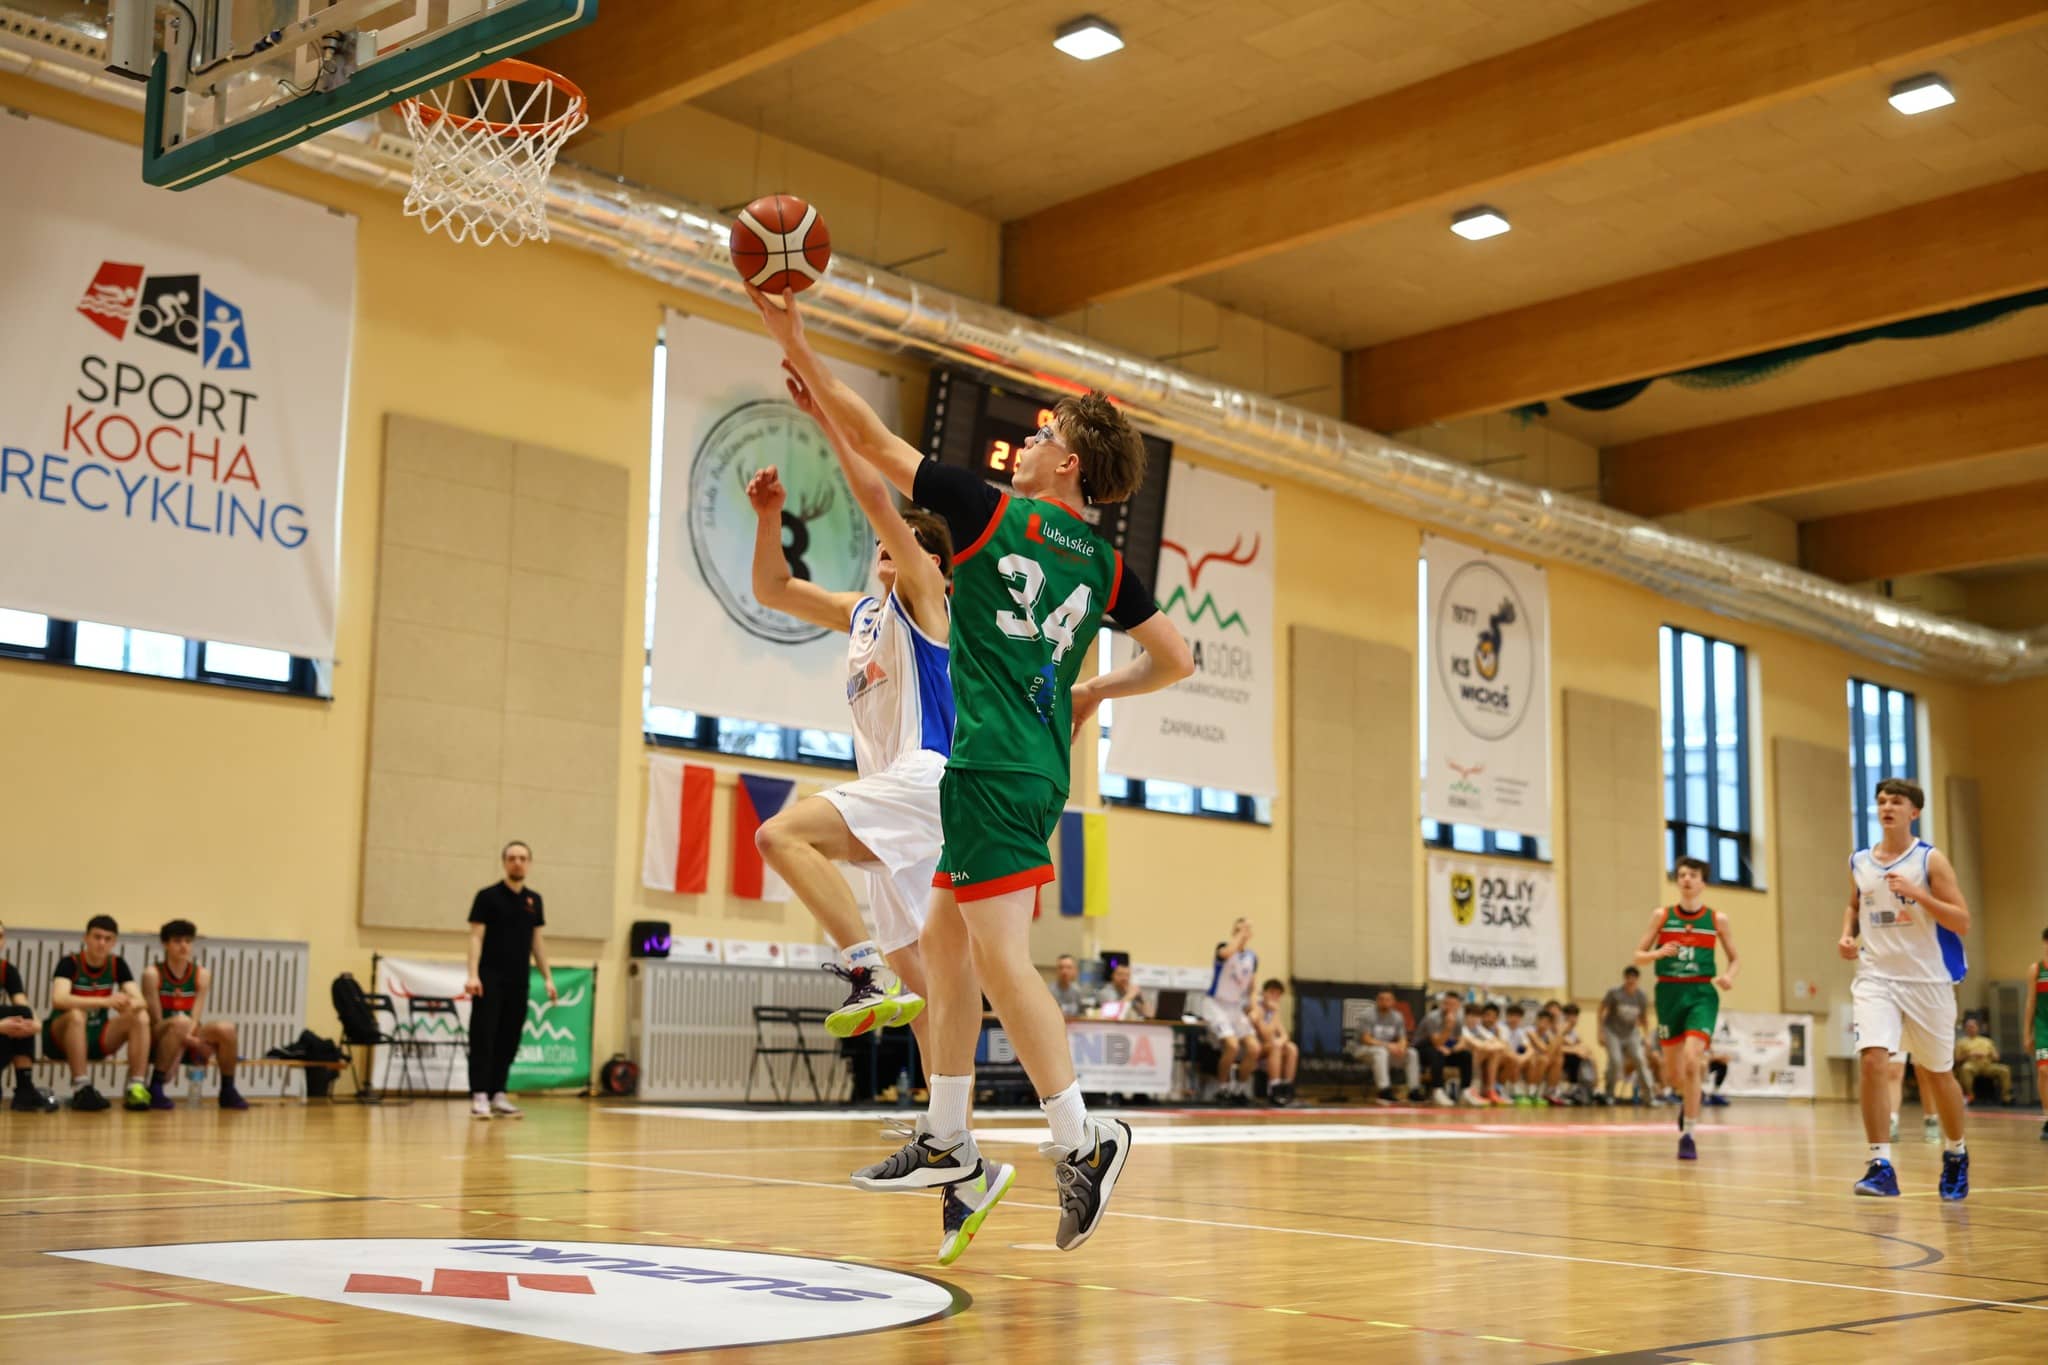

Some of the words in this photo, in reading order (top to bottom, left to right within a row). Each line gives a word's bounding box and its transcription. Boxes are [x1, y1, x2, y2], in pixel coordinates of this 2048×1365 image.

[77, 355, 258, 437] SPORT
[63, 404, 261, 491] KOCHA
[0, 446, 309, 549] RECYKLING
[1042, 521, 1095, 557] lubelskie
[996, 553, 1093, 666] 34
[1451, 656, 1471, 679] KS
[1678, 945, 1696, 961] 21
[1073, 1032, 1157, 1067] NBA
[448, 1243, 894, 1302] SUZUKI
